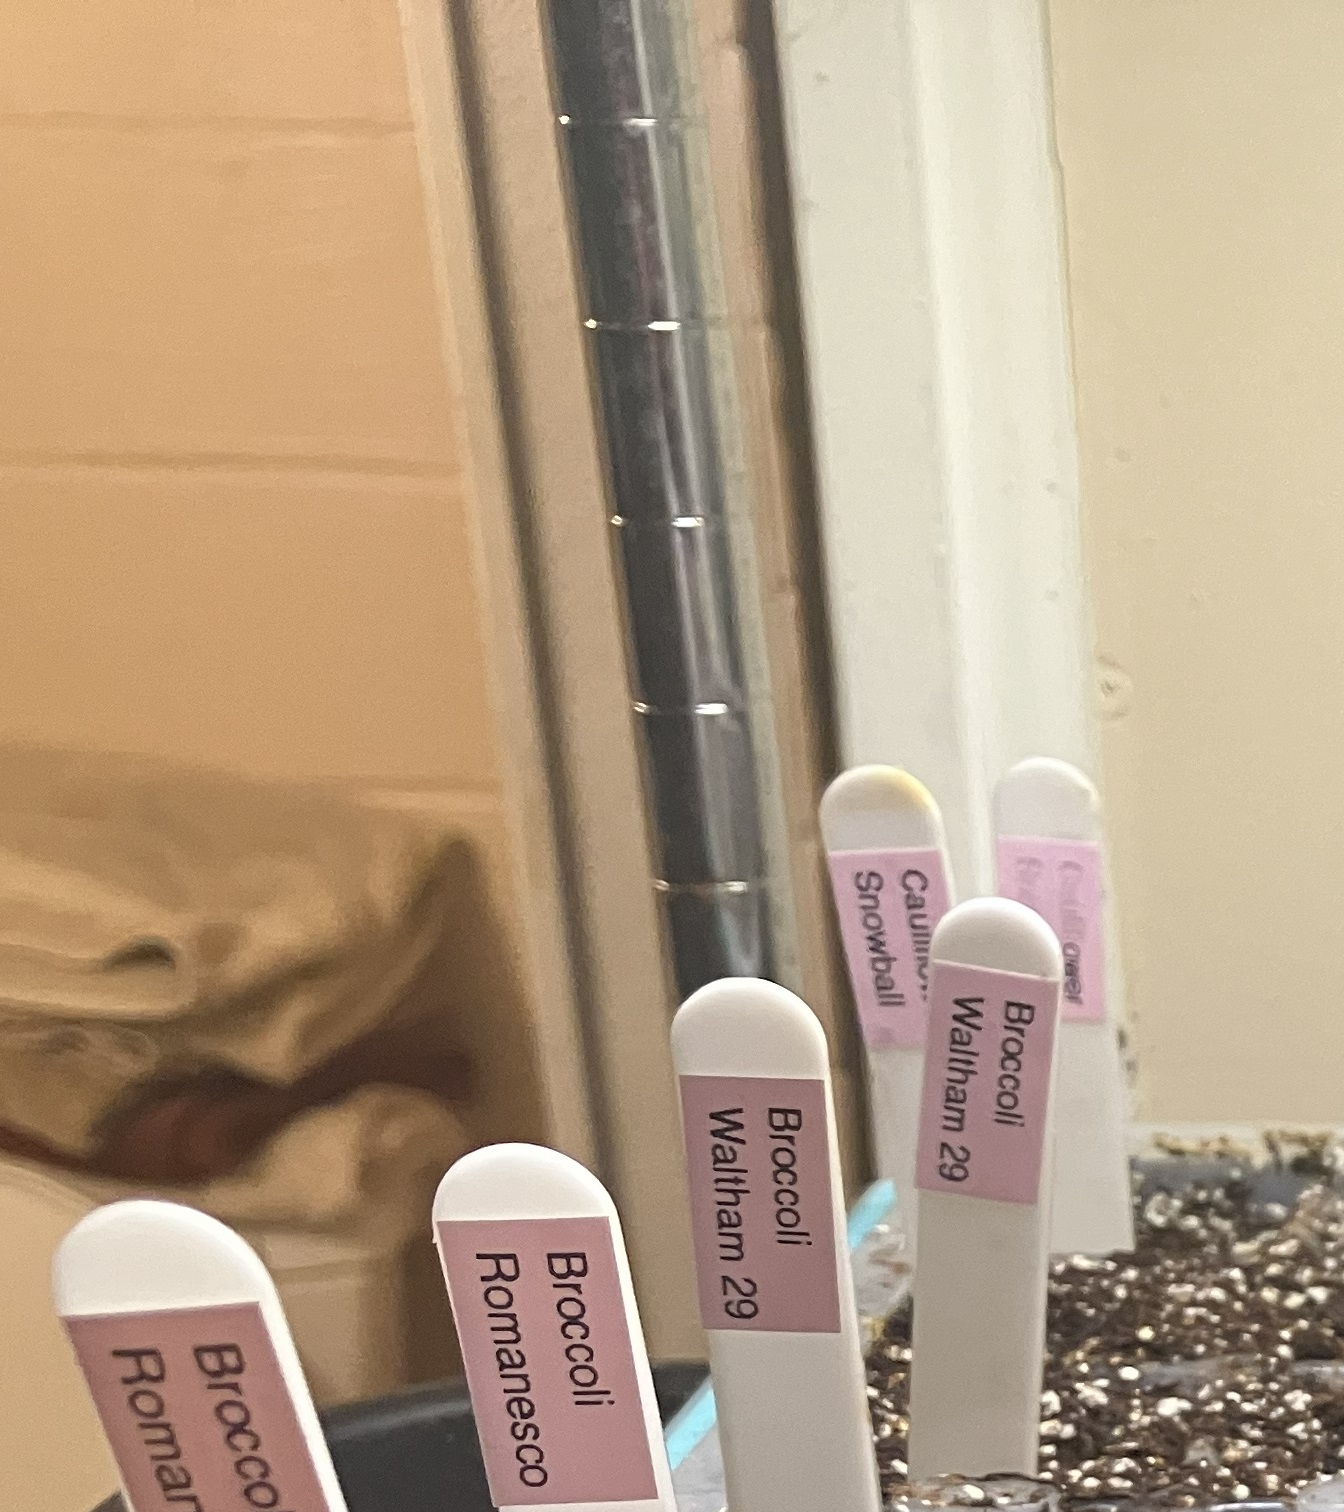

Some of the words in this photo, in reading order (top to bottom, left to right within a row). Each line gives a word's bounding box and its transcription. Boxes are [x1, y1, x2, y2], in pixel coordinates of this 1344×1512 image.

[854, 871, 905, 1007] Snowball
[941, 997, 984, 1132] Waltham
[994, 1000, 1036, 1128] Broccoli
[708, 1107, 751, 1262] Waltham
[768, 1106, 813, 1246] Broccoli
[939, 1142, 970, 1182] 29
[547, 1251, 615, 1407] Broccoli
[721, 1275, 759, 1320] 29
[475, 1252, 549, 1488] Romanesco
